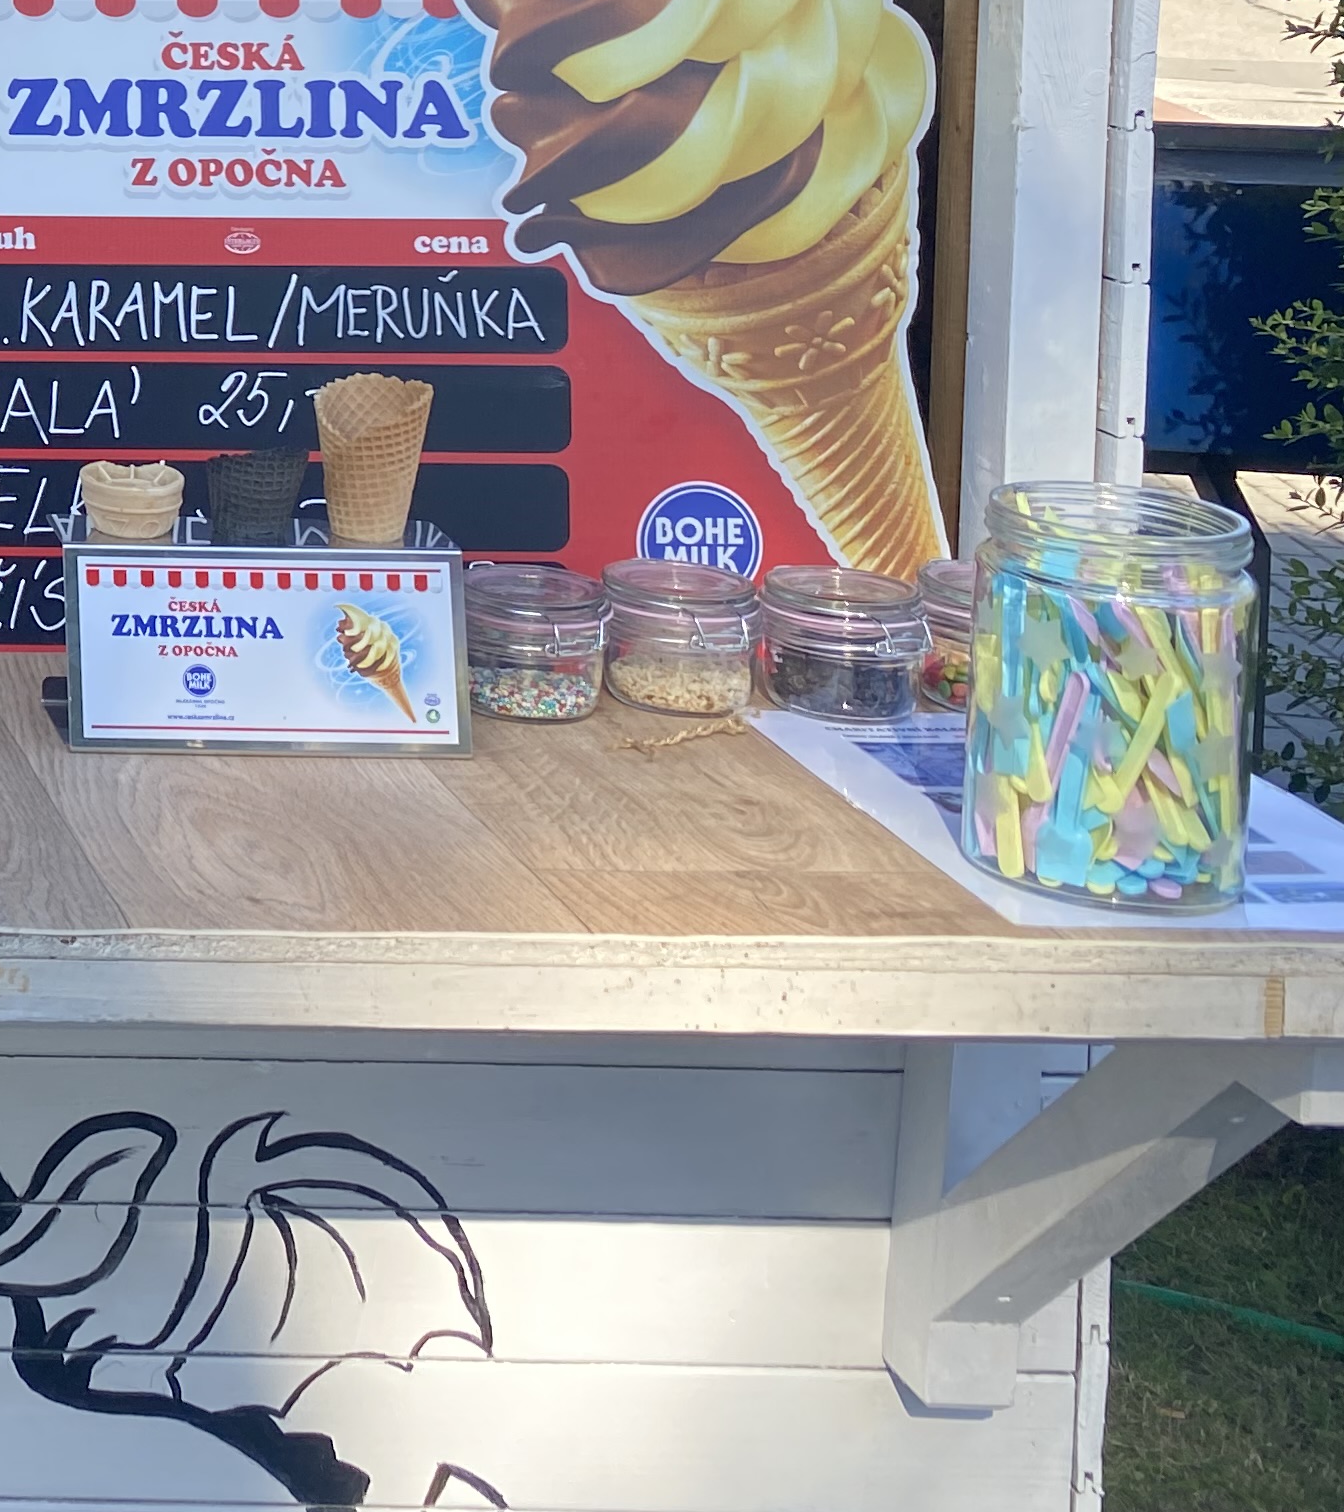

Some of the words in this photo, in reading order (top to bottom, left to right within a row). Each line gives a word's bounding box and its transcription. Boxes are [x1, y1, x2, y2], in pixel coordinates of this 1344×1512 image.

[161, 31, 305, 73] ČESKÁ
[8, 78, 470, 140] ZMRZLINA
[131, 157, 158, 188] Z
[167, 148, 347, 189] OPOČNA
[413, 232, 490, 255] cena
[655, 516, 744, 545] BOHE
[168, 596, 221, 612] ČESKÁ
[111, 614, 284, 639] ZMRZLINA
[158, 645, 169, 656] Z
[172, 642, 238, 657] OPOČNA
[186, 672, 212, 681] BOHE
[188, 681, 211, 690] MILK
